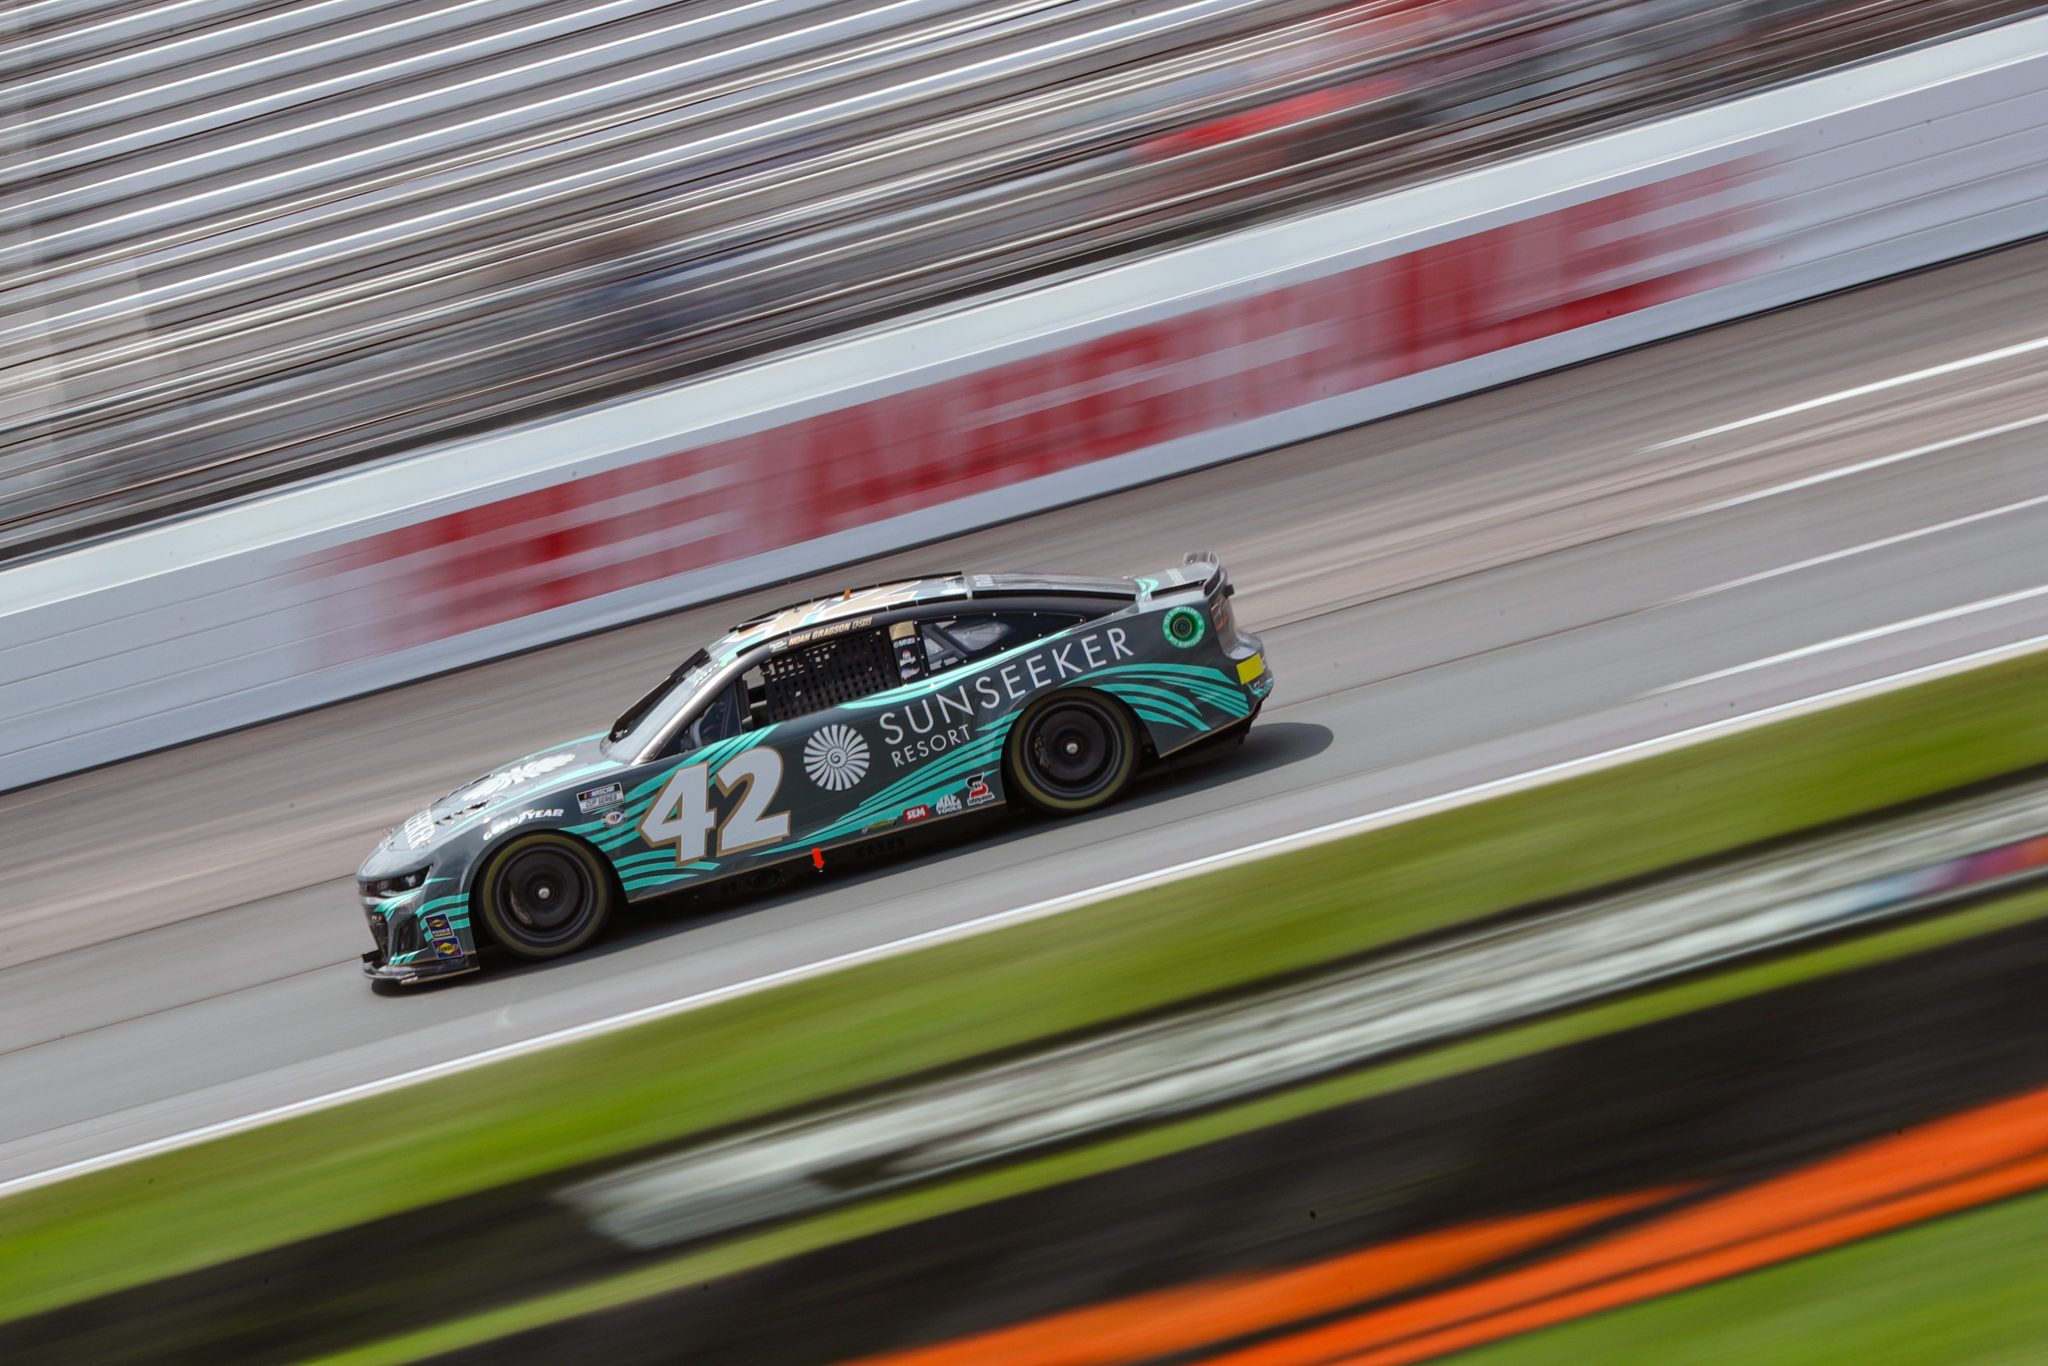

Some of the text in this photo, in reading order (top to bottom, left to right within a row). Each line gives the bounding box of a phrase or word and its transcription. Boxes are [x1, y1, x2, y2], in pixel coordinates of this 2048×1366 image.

[788, 633, 811, 647] NOAH
[811, 621, 851, 640] GRAGSON
[879, 627, 1134, 746] SUNSEEKER
[890, 723, 971, 768] RESORT
[635, 745, 791, 867] 42
[906, 806, 927, 820] SEM
[935, 793, 962, 811] MAC
[483, 808, 565, 841] GOODYEAR
